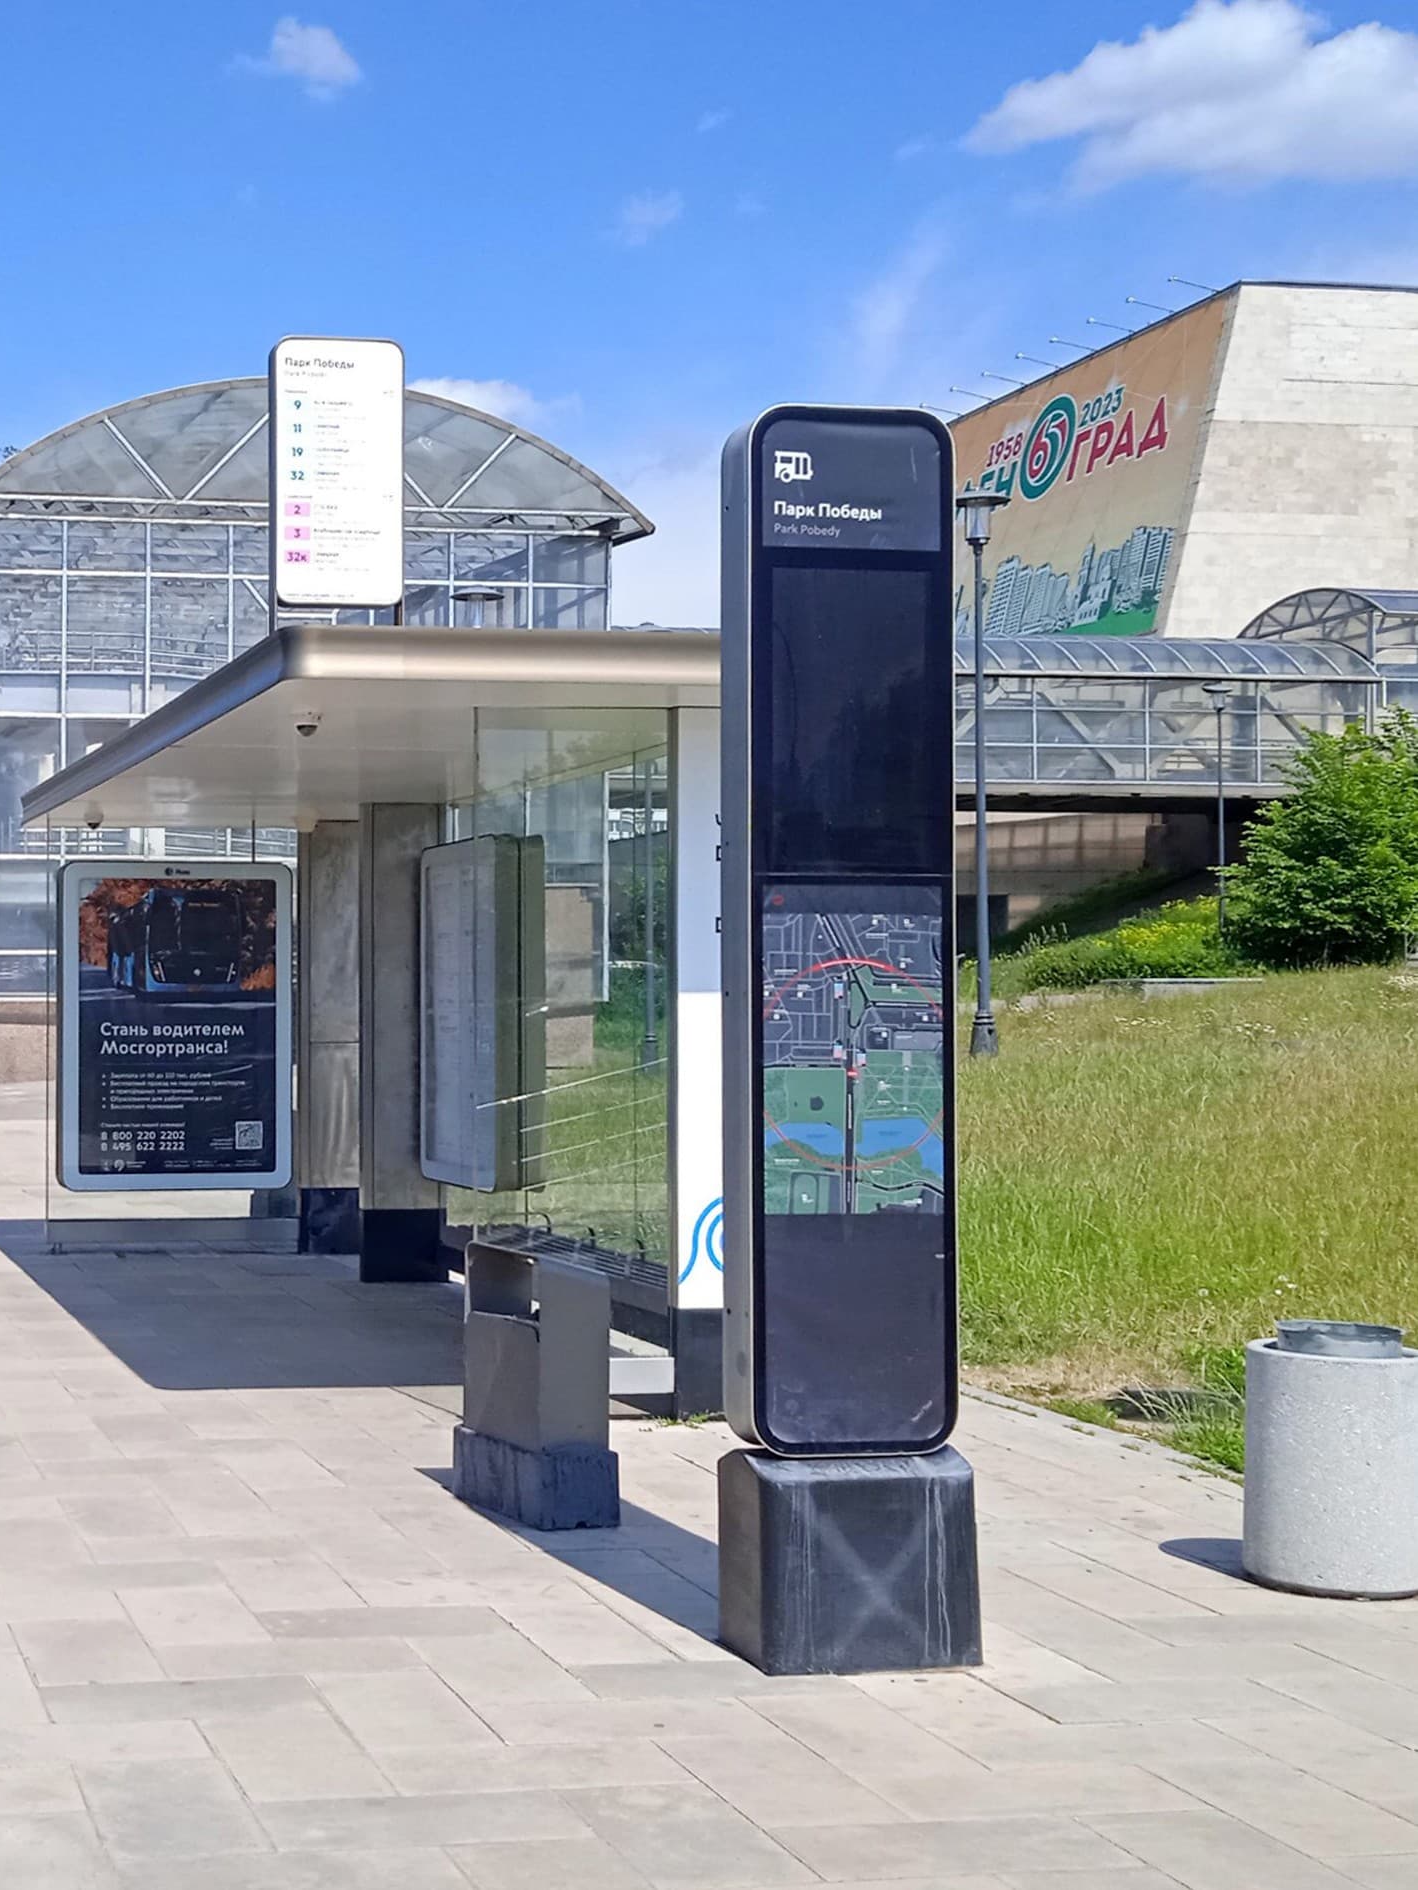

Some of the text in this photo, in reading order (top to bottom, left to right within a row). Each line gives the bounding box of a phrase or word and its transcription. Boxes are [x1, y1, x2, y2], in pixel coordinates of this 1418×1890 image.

[285, 357, 355, 369] Парк Победы
[293, 400, 302, 410] 9
[1080, 384, 1125, 428] 2023
[293, 423, 302, 433] 11
[291, 447, 304, 457] 19
[986, 432, 1024, 468] 1958
[290, 470, 305, 480] 32
[293, 504, 301, 515] 2
[773, 500, 883, 521] Парк Победы
[293, 528, 301, 538] 3
[773, 523, 841, 538] Park Pobedy
[100, 1022, 245, 1038] Стань водителем
[100, 1039, 229, 1058] Мосгортранса!
[112, 1131, 133, 1140] 800
[136, 1130, 157, 1140] 220
[160, 1130, 185, 1140] 2202
[112, 1142, 132, 1151] 495
[136, 1141, 155, 1151] 622
[159, 1141, 185, 1150] 2222
